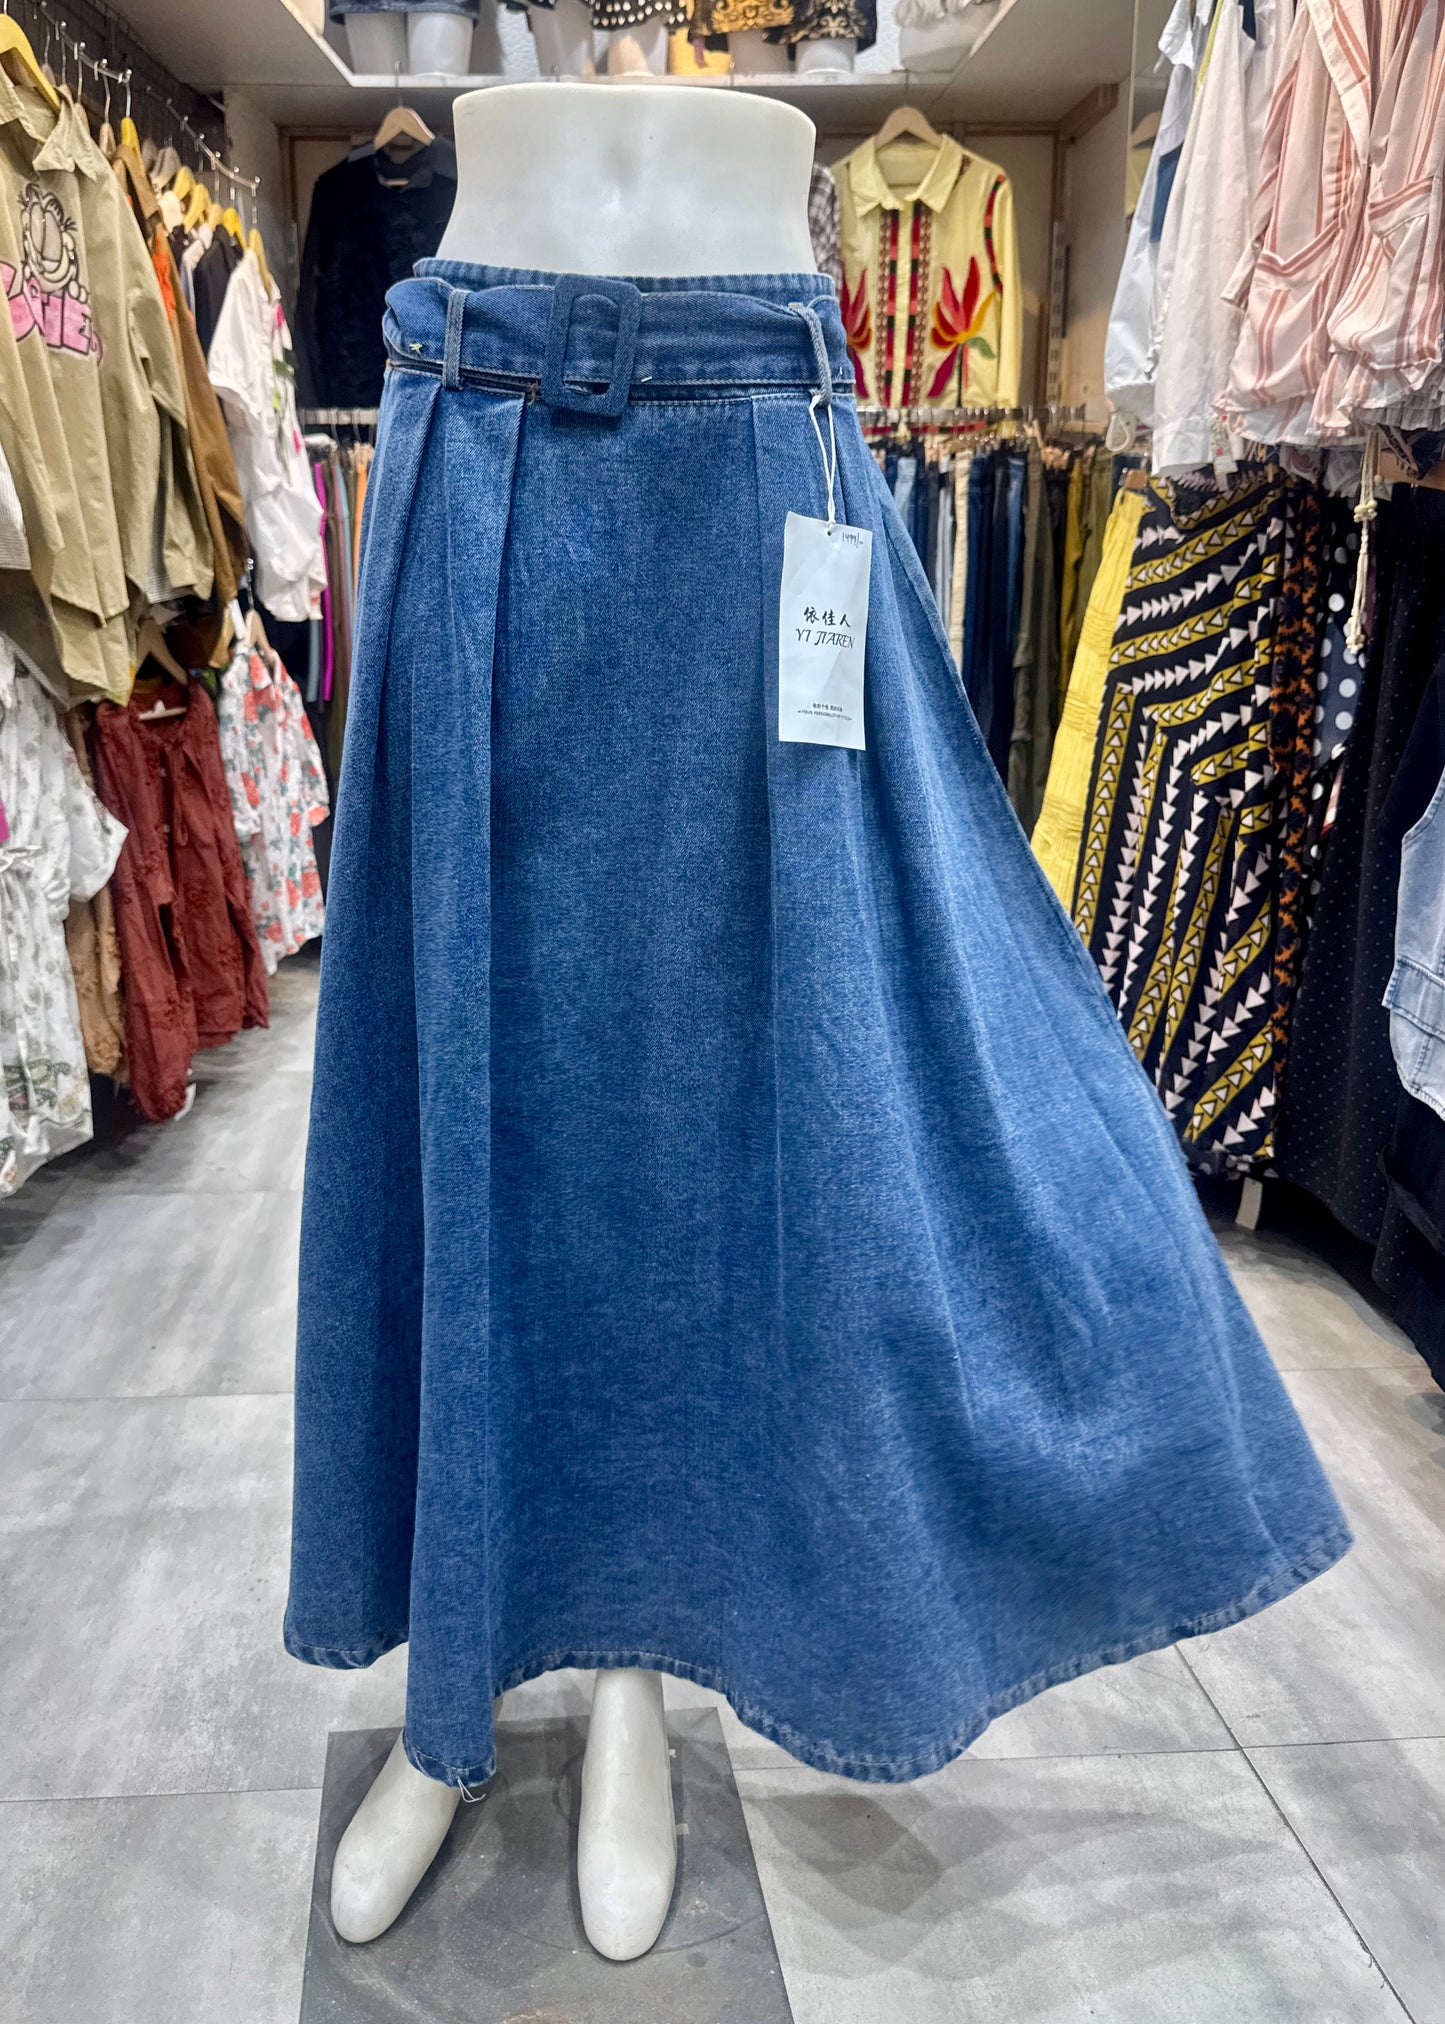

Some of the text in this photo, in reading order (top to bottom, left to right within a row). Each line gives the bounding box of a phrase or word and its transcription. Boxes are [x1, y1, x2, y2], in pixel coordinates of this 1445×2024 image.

[803, 606, 851, 628] 依佳人
[795, 628, 856, 650] YI JIAREN
